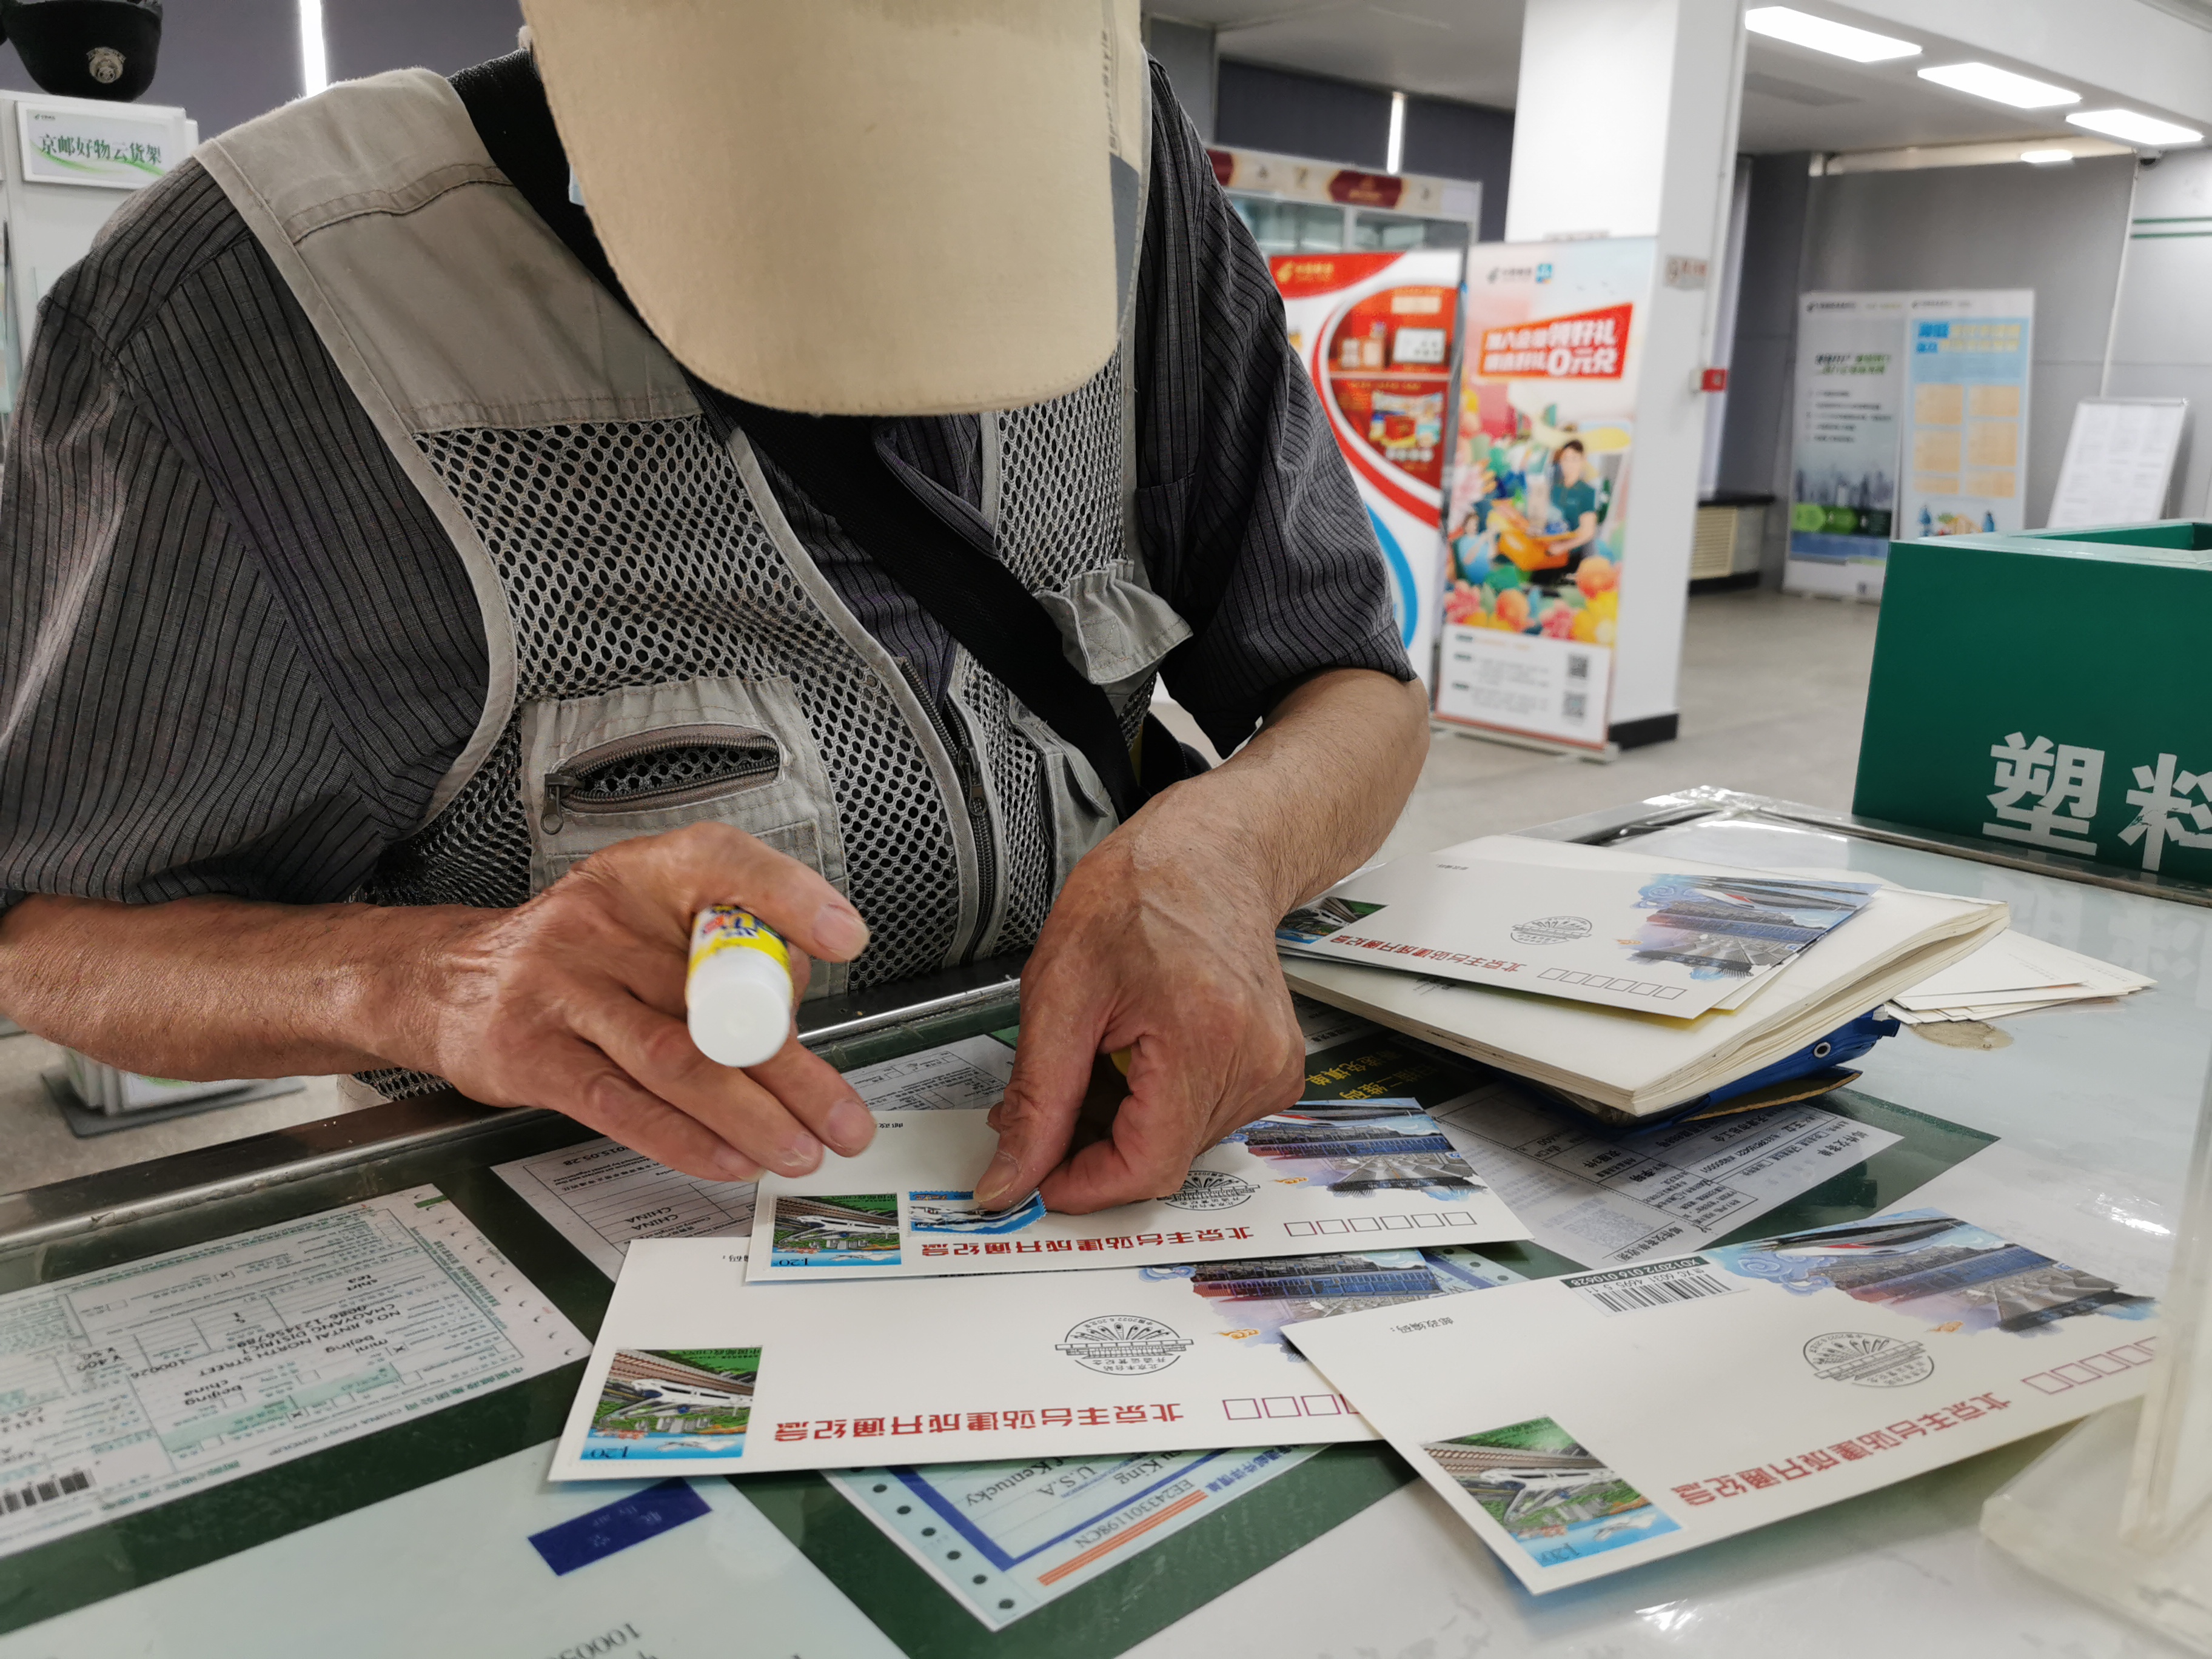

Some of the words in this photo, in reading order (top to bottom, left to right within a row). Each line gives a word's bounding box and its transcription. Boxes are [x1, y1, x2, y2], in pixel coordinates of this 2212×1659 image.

[39, 133, 162, 166] 京邮好物云货架
[1329, 934, 1526, 972] 北京丰台站建成开通纪念
[874, 1121, 903, 1129] 邮政
[624, 1205, 672, 1224] CHINA
[631, 1213, 679, 1232] CHINA
[921, 1226, 1253, 1256] 北京丰台站建成开通纪念
[347, 1273, 371, 1284] tea
[1570, 1270, 1616, 1285] 010628
[1618, 1267, 1644, 1278] 016
[1647, 1272, 1674, 1282] 6031
[1603, 1283, 1612, 1292] 5
[1615, 1278, 1643, 1288] 4695
[310, 1303, 395, 1333] CHAOYANG
[241, 1330, 306, 1354] DISTRICT
[256, 1337, 311, 1358] NORTH
[198, 1355, 252, 1376] STREET
[1091, 1356, 1165, 1365] 开通运营纪念
[184, 1379, 228, 1396] china
[773, 1403, 1182, 1442] 北京丰台站建成开通纪念
[1669, 1390, 2011, 1506] 北京丰台站建成开通纪念
[1112, 1456, 1163, 1486] King
[964, 1459, 1052, 1507] Kentucky
